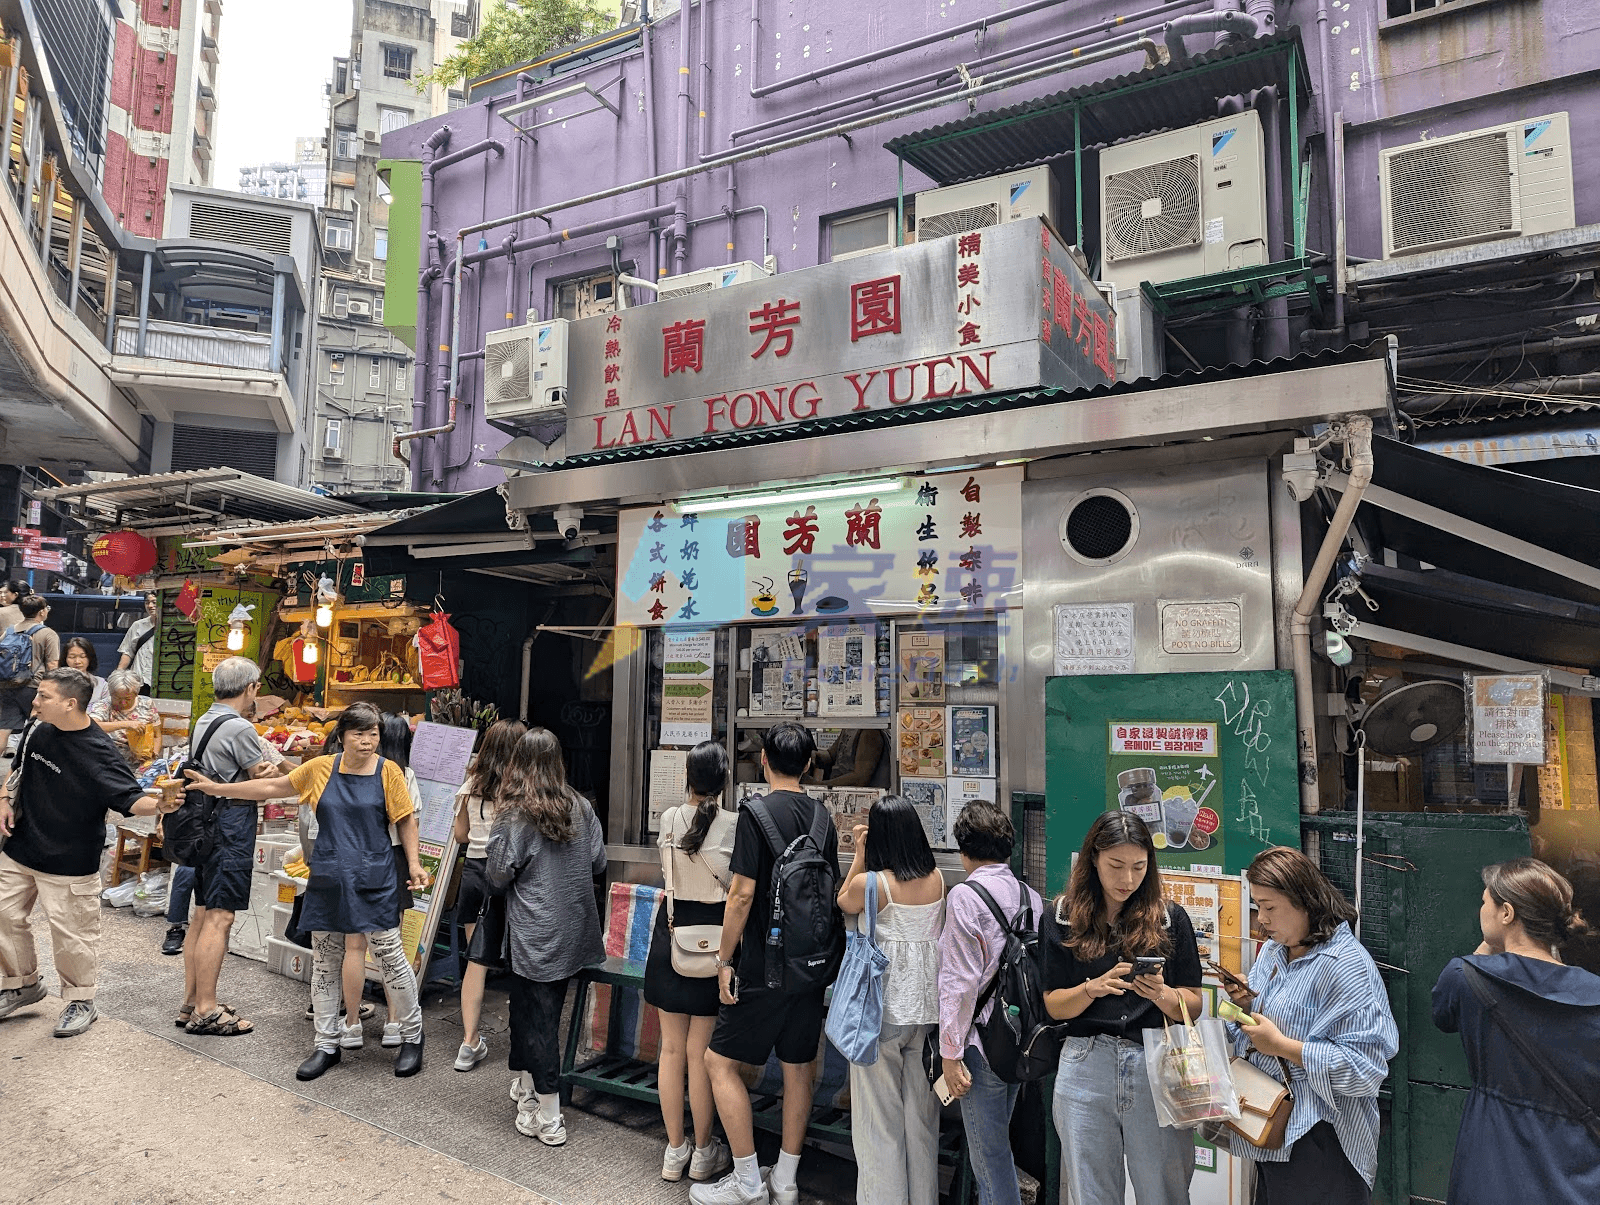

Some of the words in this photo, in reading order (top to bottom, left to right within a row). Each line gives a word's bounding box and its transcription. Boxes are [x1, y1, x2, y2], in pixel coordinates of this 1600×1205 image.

[957, 233, 982, 347] 精美小食
[662, 275, 901, 378] 蘭芳園
[1053, 265, 1109, 379] 蘭芳園
[604, 314, 621, 408] 冷熱飲品
[593, 406, 675, 449] LAN
[704, 382, 823, 433] FONG
[845, 351, 996, 410] YUEN
[647, 510, 668, 621] 各式餅食
[1175, 619, 1188, 627] NO
[1190, 619, 1227, 627] GRAFFITI
[1194, 640, 1207, 648] NO
[1210, 640, 1232, 648] BILLS
[1484, 707, 1530, 717] 請往對面
[1495, 719, 1517, 729] 排隊
[1124, 740, 1161, 751] 홈메이드
[1503, 741, 1540, 750] opposite
